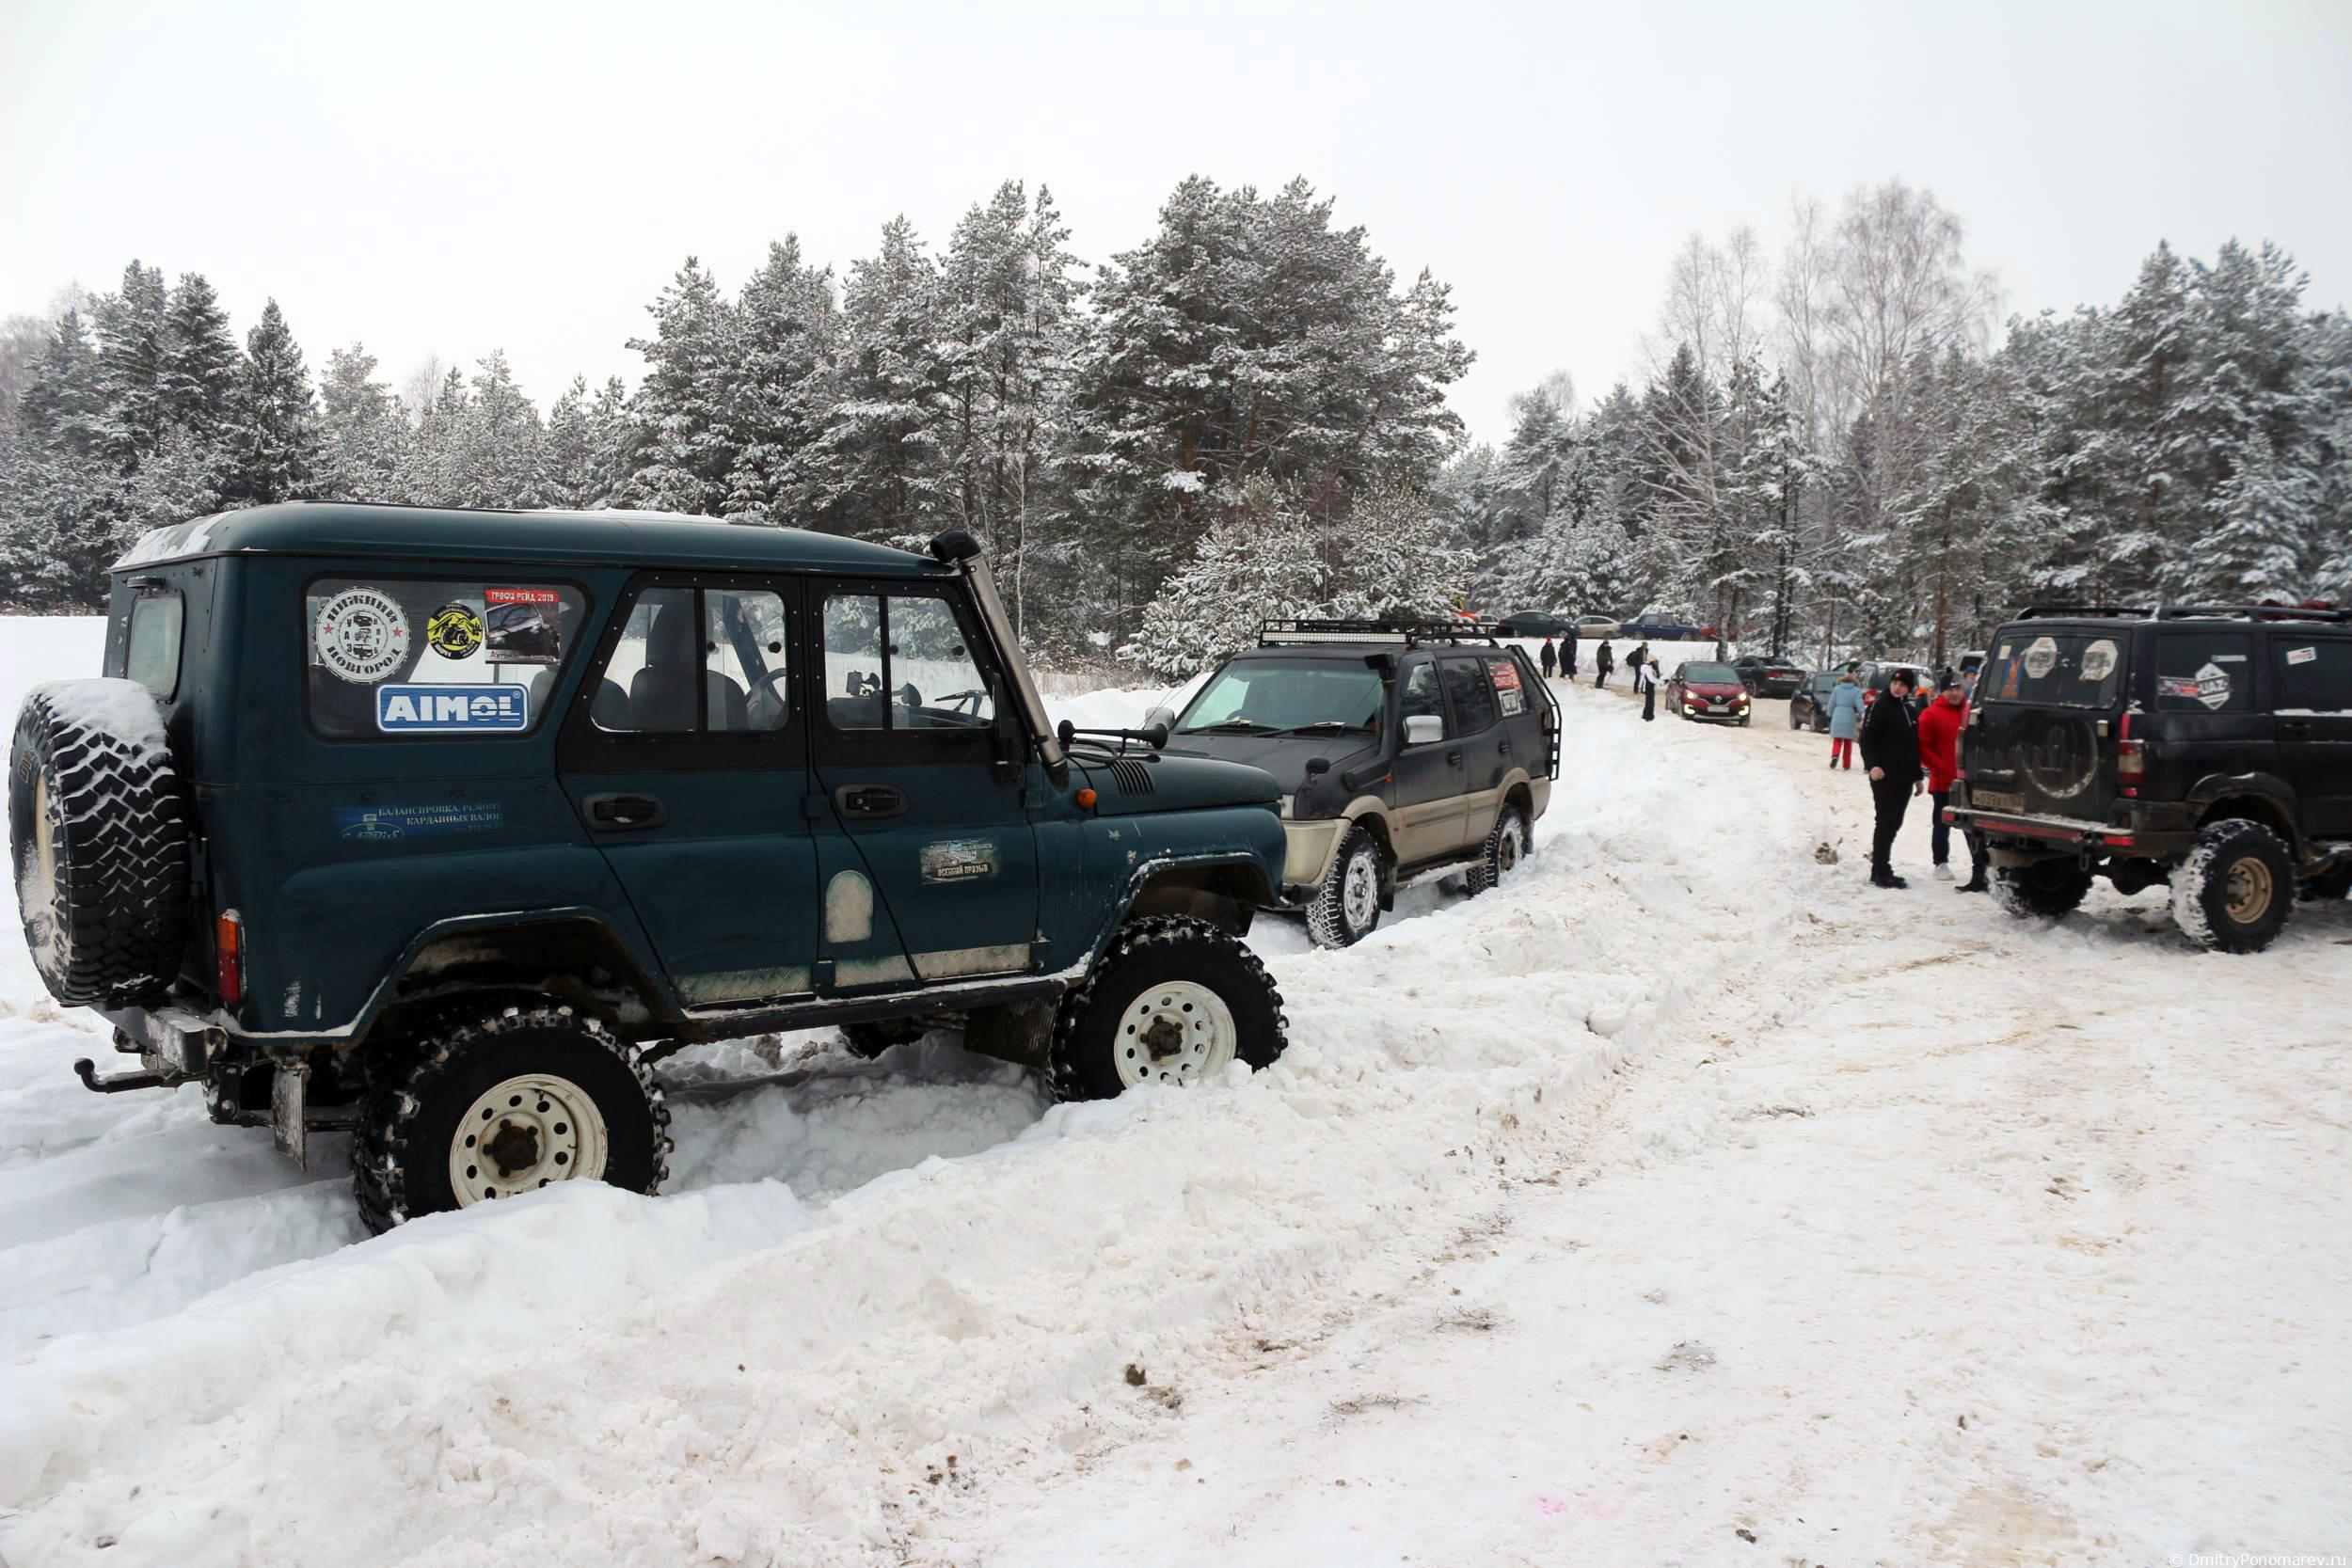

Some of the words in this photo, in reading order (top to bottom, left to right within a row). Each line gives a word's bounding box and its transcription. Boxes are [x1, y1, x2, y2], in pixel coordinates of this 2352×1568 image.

[516, 592, 535, 602] РЕЙД
[537, 594, 554, 602] 2019
[326, 594, 398, 624] НИЖНИЙ
[326, 645, 403, 674] НОВГОРОД
[384, 695, 520, 721] AIMOL
[378, 804, 460, 817] БАЛАНСИРОВКА,
[406, 815, 468, 826] КАРДАННЫХ
[937, 865, 963, 877] ОСЕННИЙ
